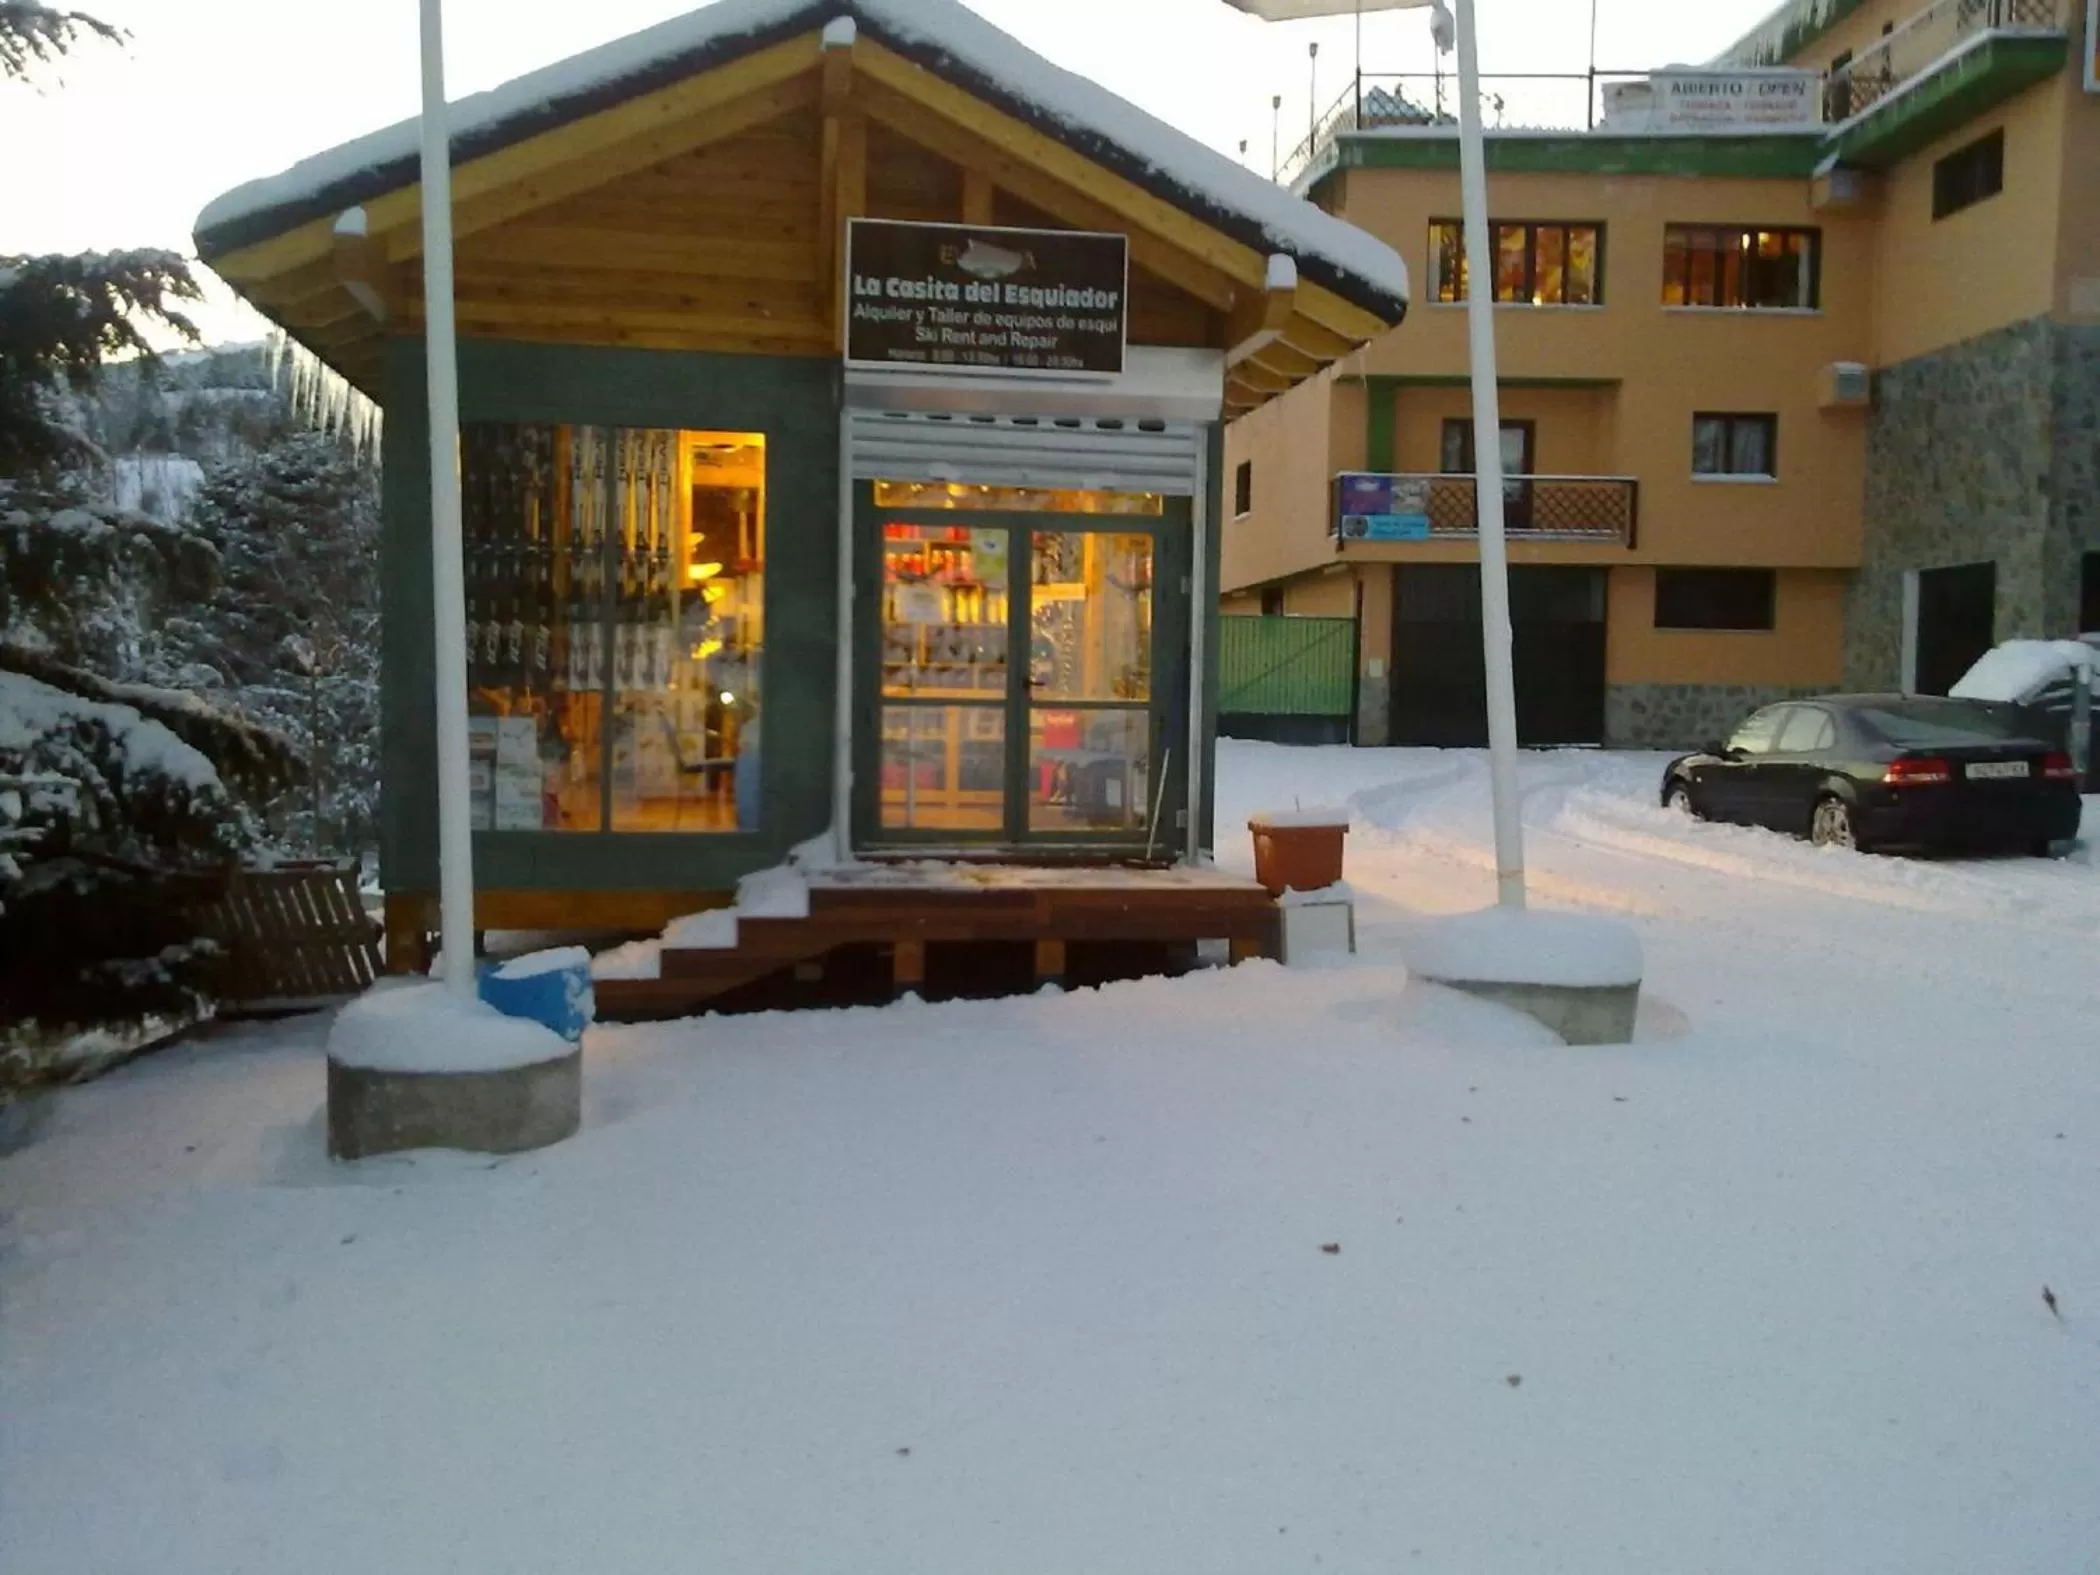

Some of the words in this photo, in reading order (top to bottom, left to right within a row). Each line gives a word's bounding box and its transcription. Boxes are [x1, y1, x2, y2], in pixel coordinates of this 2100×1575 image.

[1757, 80, 1807, 97] OPEN
[854, 274, 881, 296] La
[885, 274, 959, 300] Casita
[964, 280, 1000, 303] del
[1004, 283, 1119, 309] Esquiador
[853, 302, 913, 323] Alquiler
[915, 309, 925, 325] y
[927, 306, 970, 324] Taller
[973, 309, 992, 326] de
[994, 312, 1054, 331] equipos
[1055, 315, 1075, 331] de
[915, 326, 938, 342] Ski
[942, 328, 977, 345] Rent
[979, 331, 1007, 347] and
[1010, 332, 1059, 350] Repair
